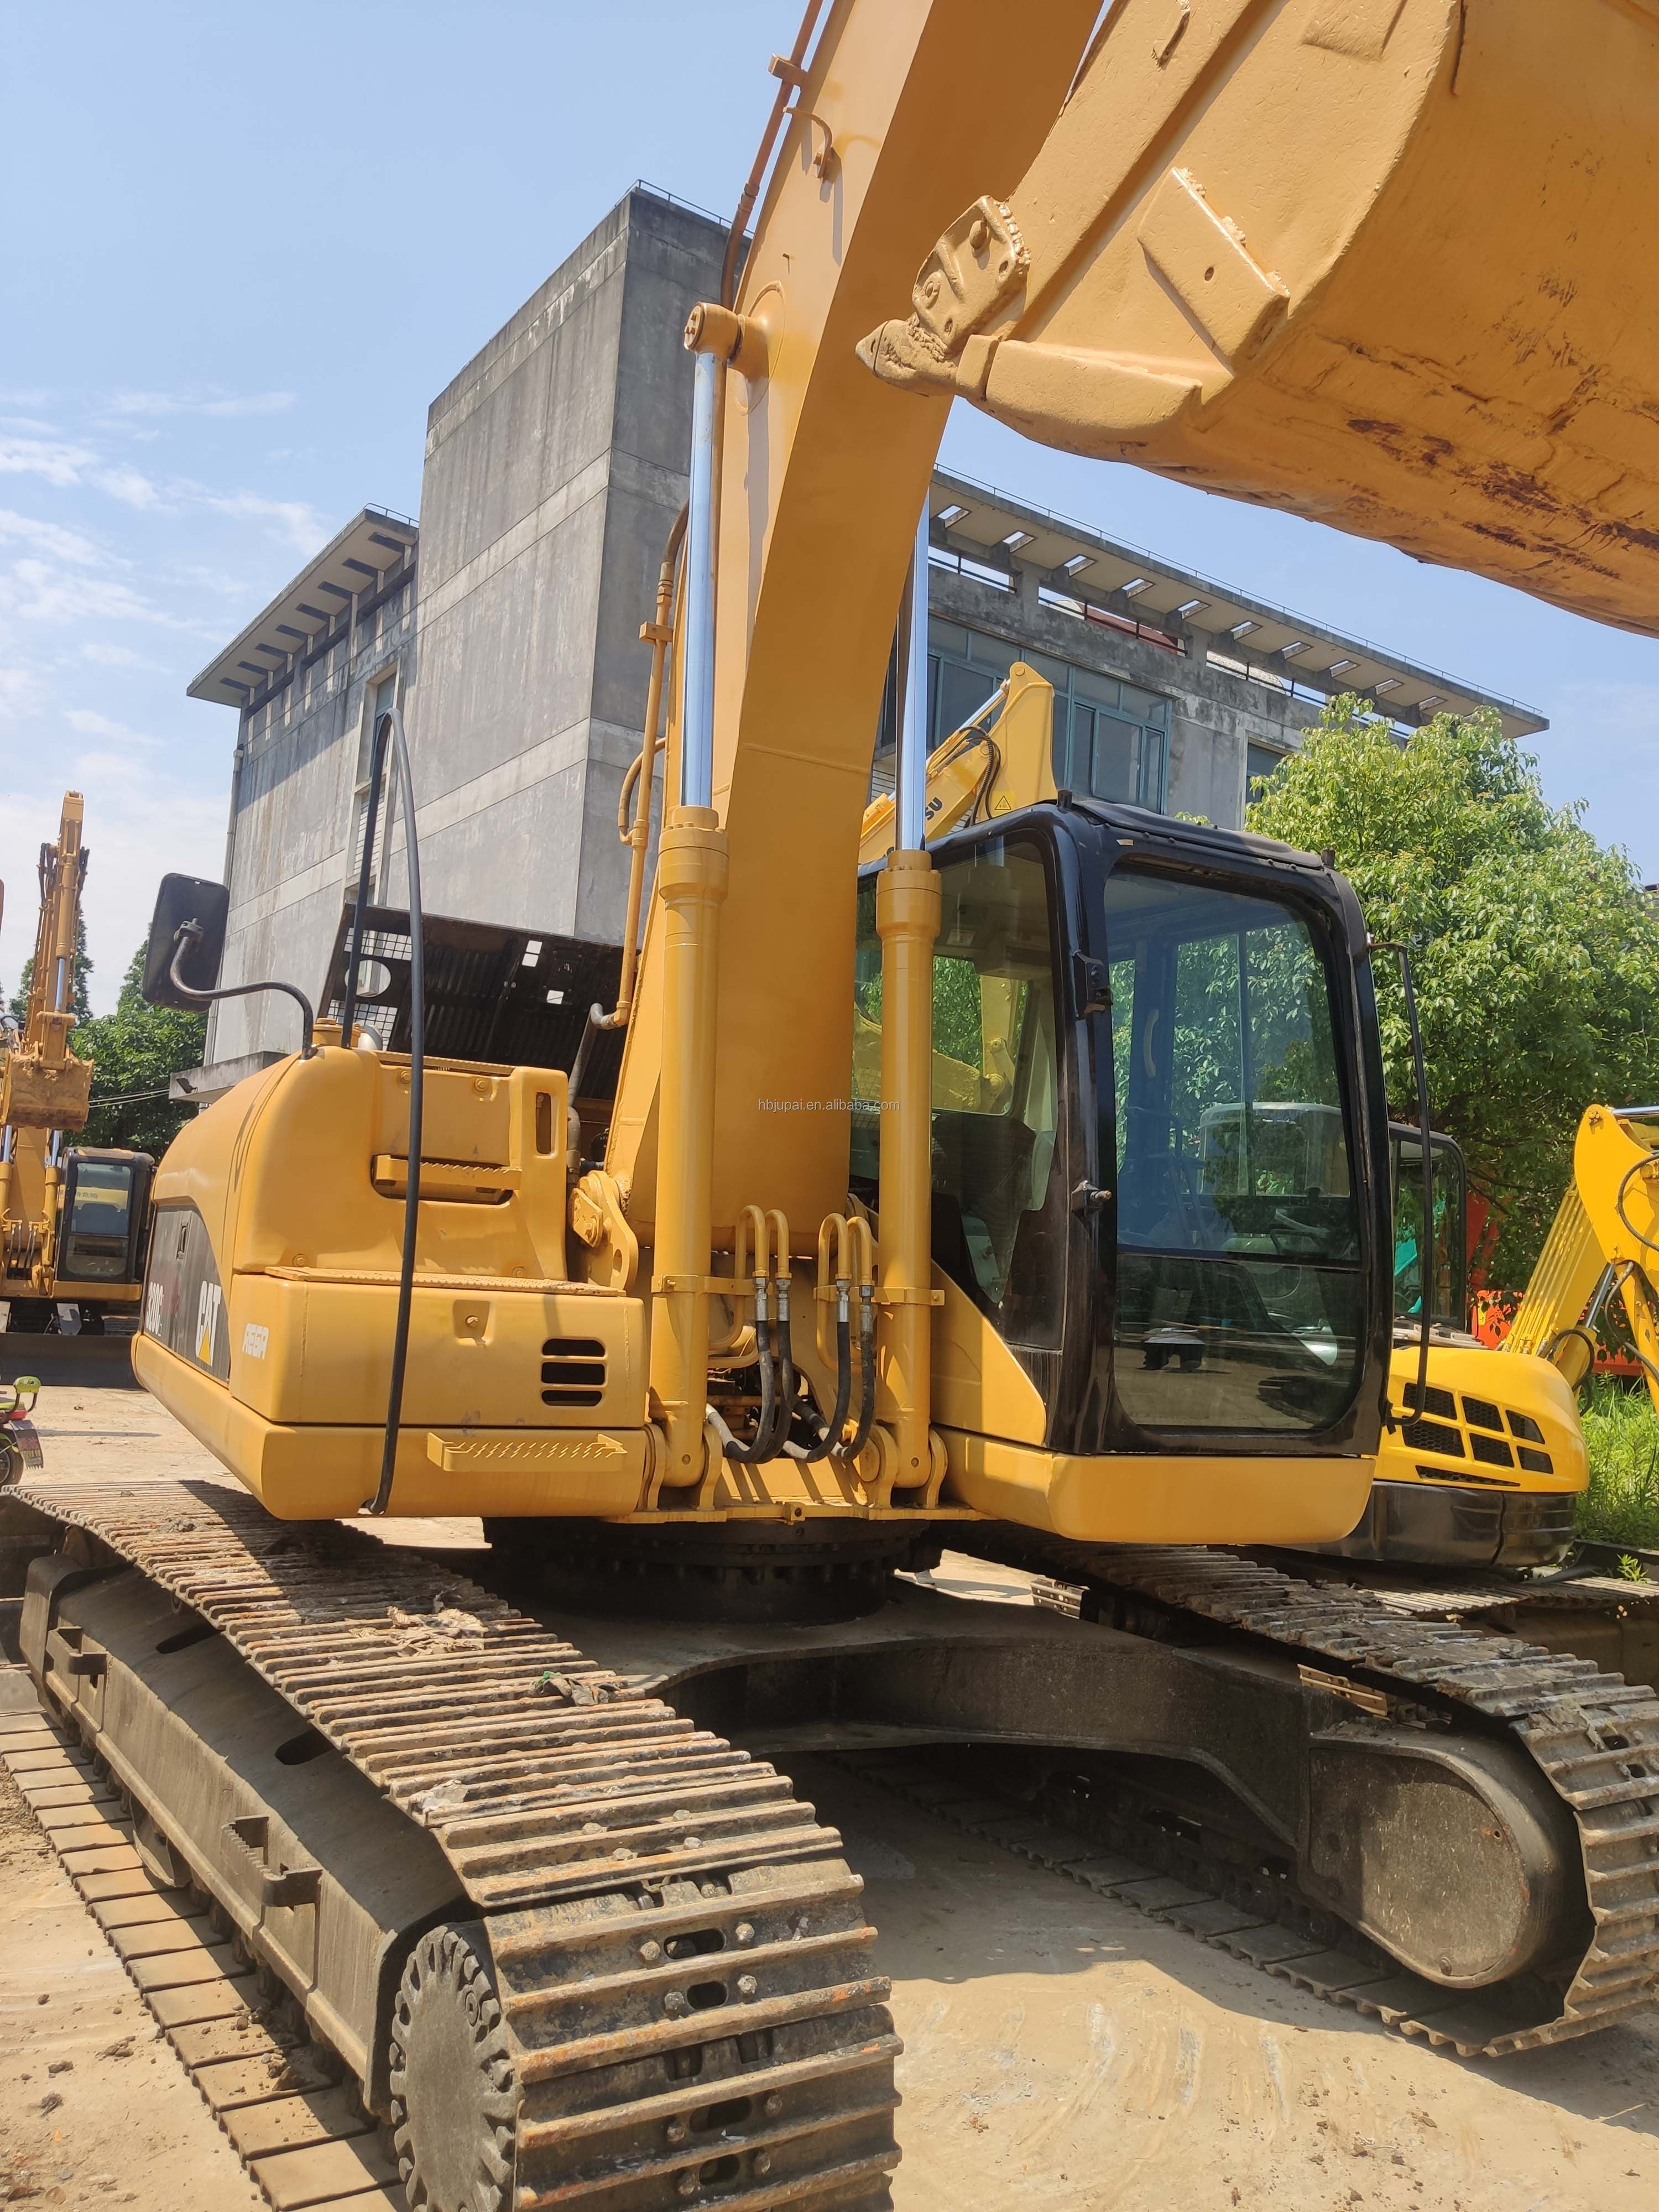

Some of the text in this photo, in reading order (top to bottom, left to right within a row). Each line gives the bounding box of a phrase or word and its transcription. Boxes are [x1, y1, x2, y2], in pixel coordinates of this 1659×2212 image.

[925, 797, 943, 821] SU
[146, 1281, 163, 1335] 320C
[195, 1280, 222, 1366] CAT
